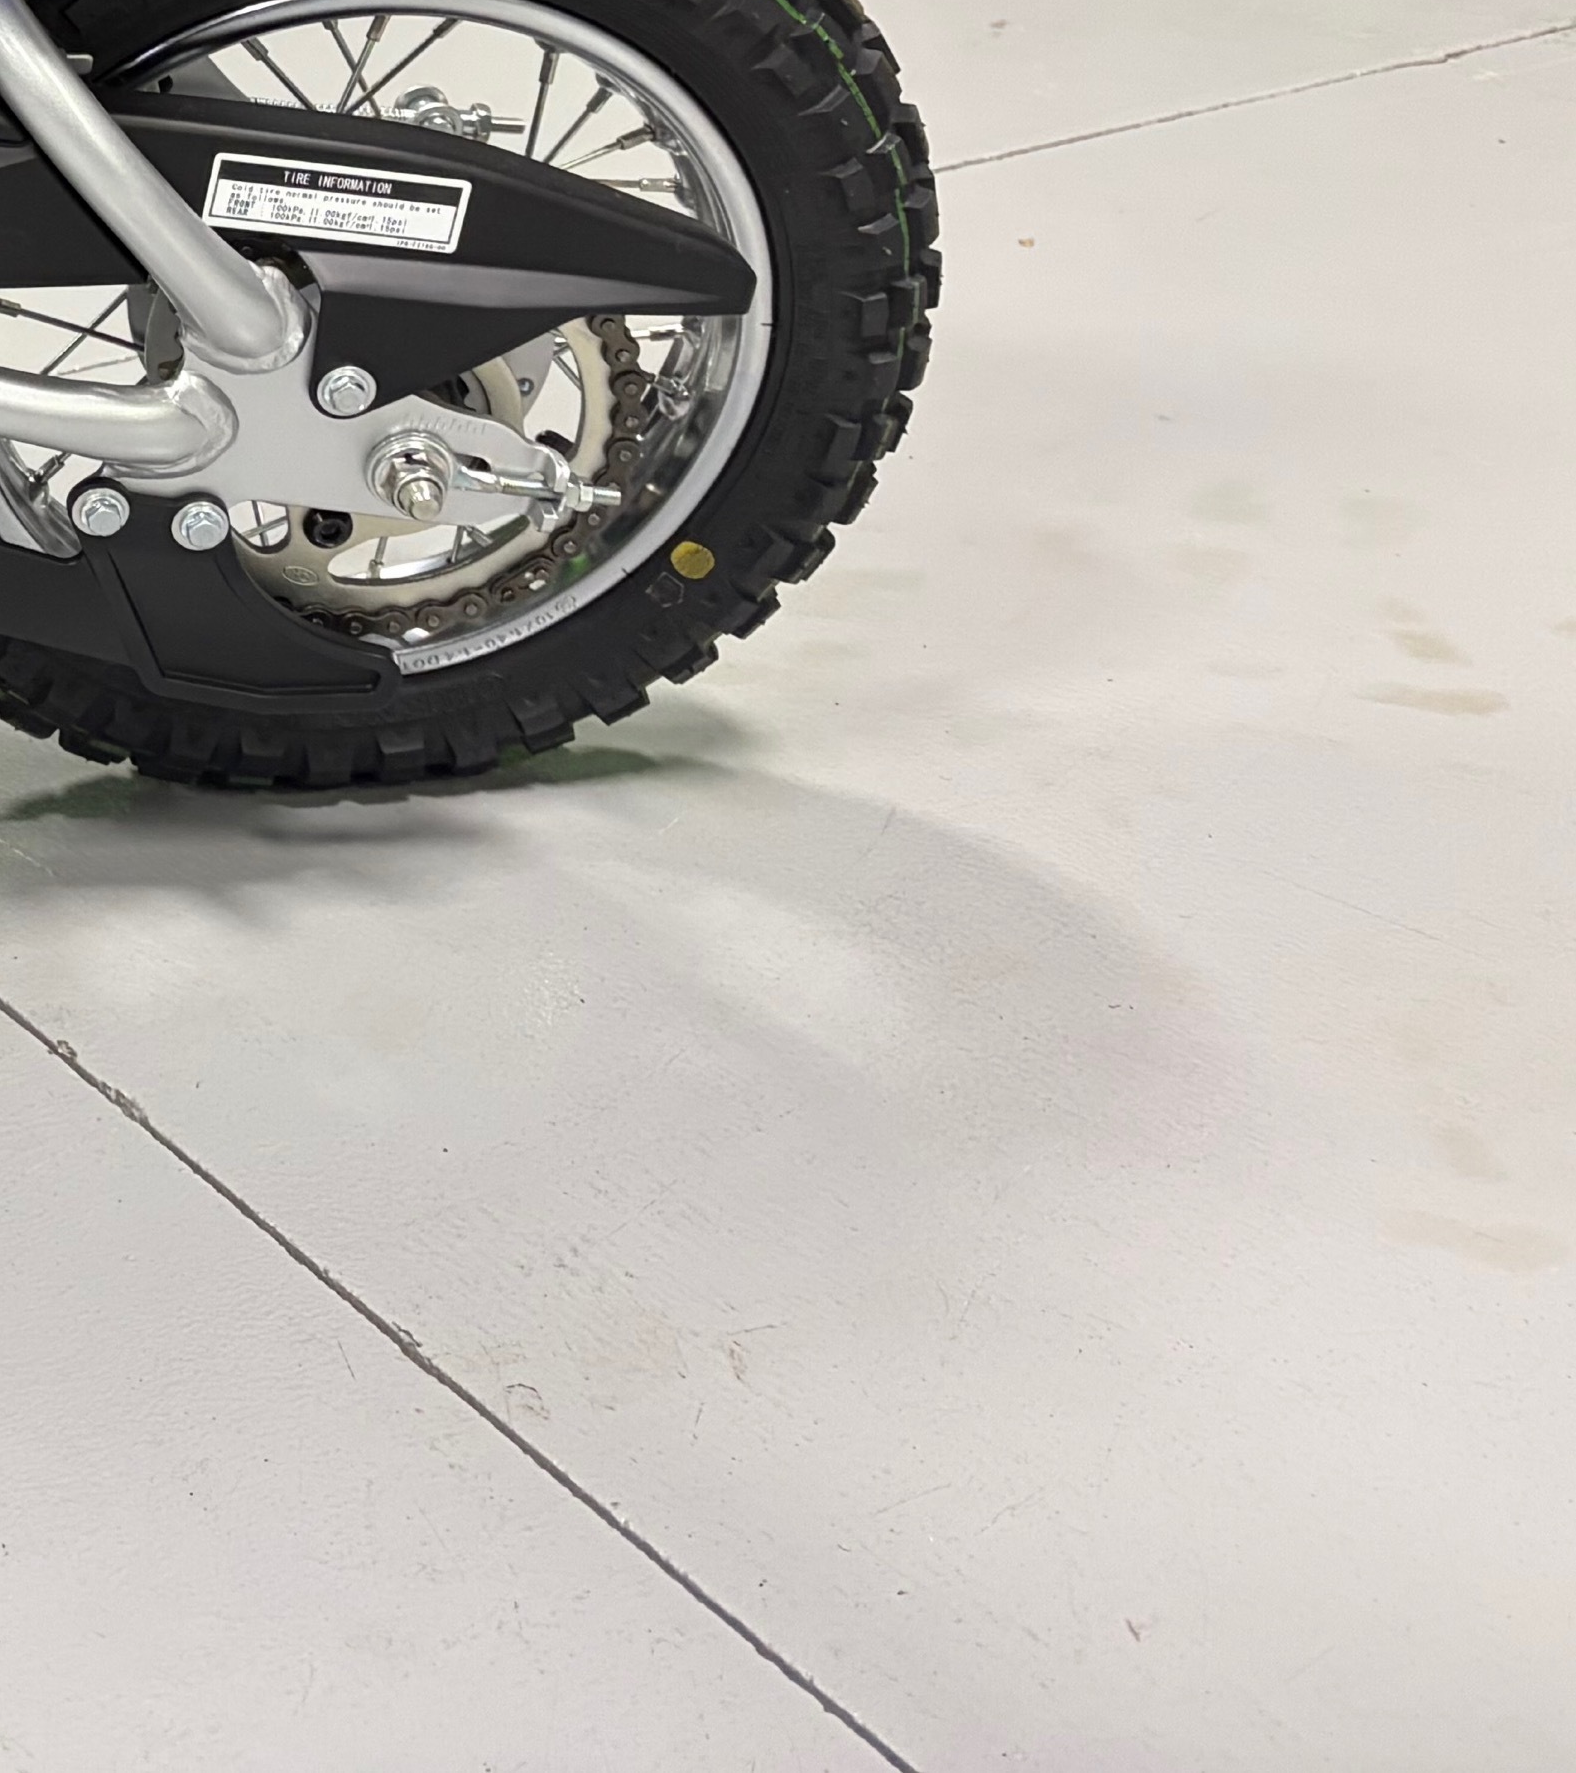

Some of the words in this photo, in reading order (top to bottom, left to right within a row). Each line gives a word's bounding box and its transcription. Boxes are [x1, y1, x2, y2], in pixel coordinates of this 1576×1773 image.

[284, 169, 310, 186] TIRE
[317, 173, 392, 195] INFORMATION
[226, 205, 249, 216] REAR
[227, 197, 256, 209] FRONT
[323, 194, 367, 206] pressure
[372, 200, 405, 210] should
[426, 207, 441, 215] set
